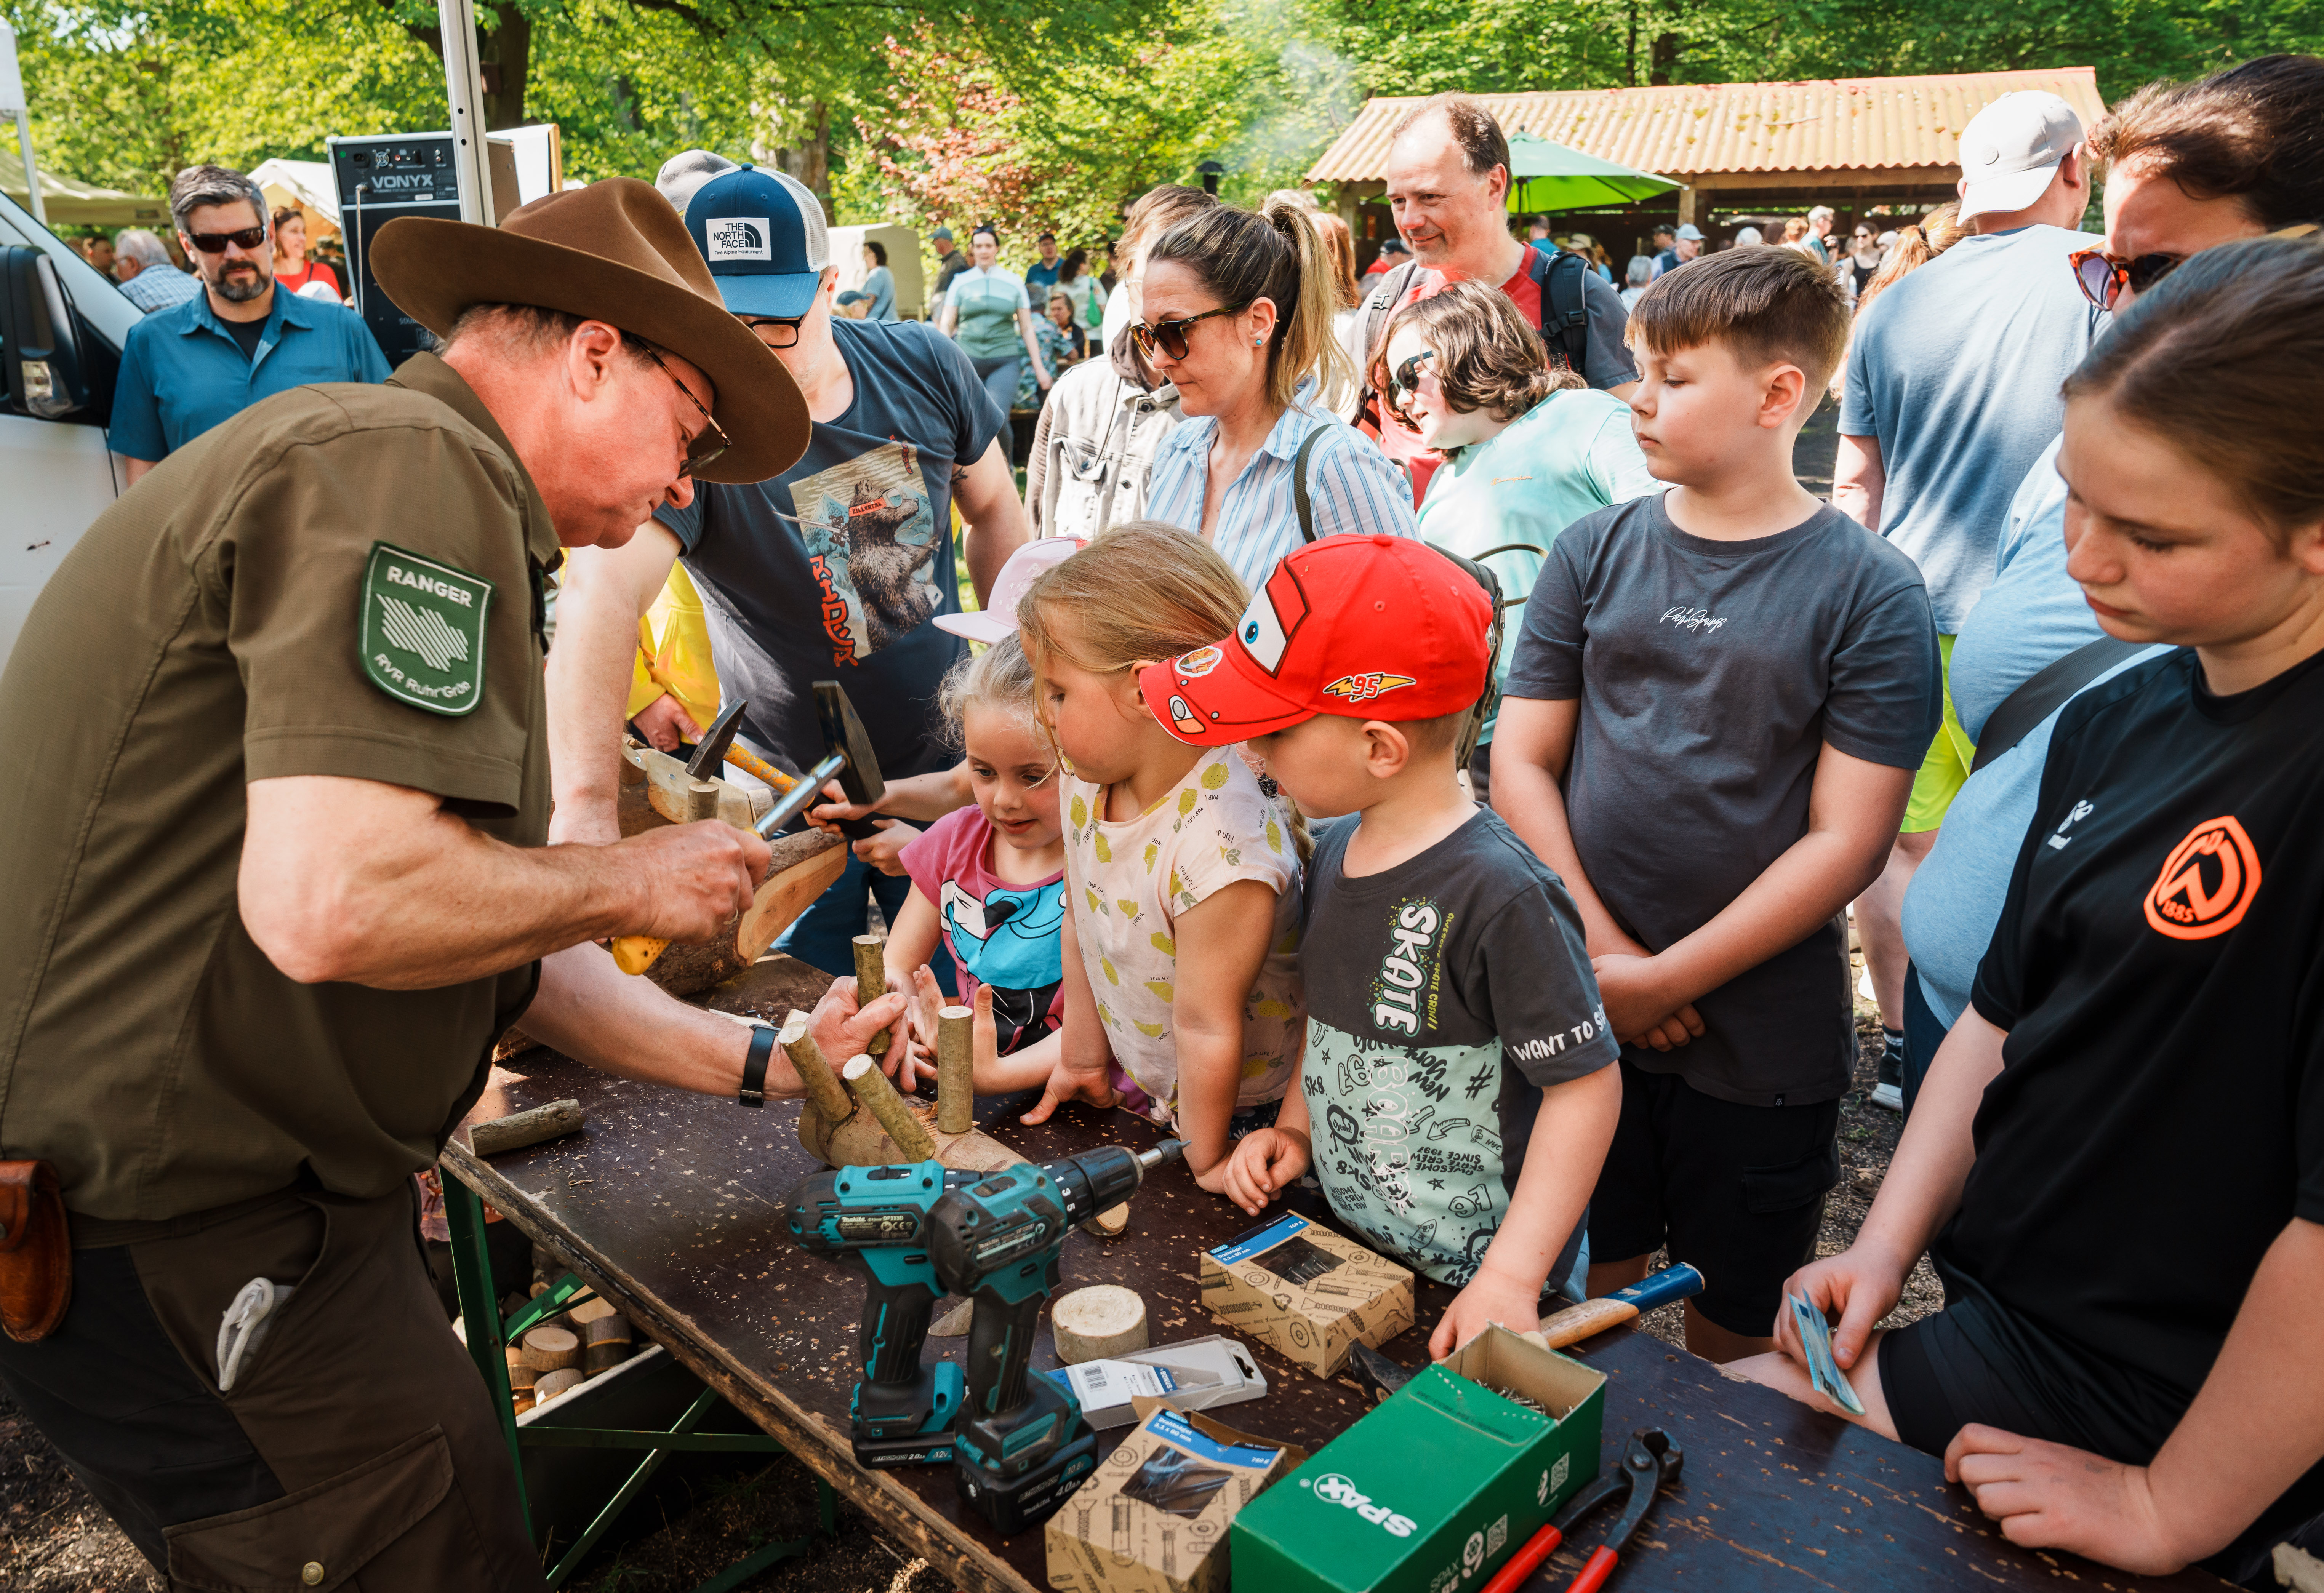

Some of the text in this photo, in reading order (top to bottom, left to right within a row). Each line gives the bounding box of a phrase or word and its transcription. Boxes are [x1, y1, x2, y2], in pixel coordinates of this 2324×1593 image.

[371, 174, 434, 188] VONYX
[714, 231, 744, 241] NORTH
[722, 240, 744, 248] FACE
[852, 501, 883, 514] ZILLERTAL
[386, 565, 472, 608] RANGER
[374, 653, 405, 683] RVR
[1349, 675, 1381, 698] 95
[2162, 899, 2194, 923] 1885
[1374, 904, 1439, 1034] SKATE
[1430, 962, 1440, 992] SKATE
[1513, 1033, 1565, 1061] WANT
[1571, 1021, 1593, 1044] TO
[1305, 1075, 1325, 1097] SK8
[1408, 1070, 1450, 1102] New
[1485, 1139, 1502, 1150] NYC
[1410, 1153, 1484, 1171] SKATE CREW
[1417, 1146, 1481, 1164] SINCE 1997
[1336, 1160, 1372, 1191] SK8
[1414, 1162, 1474, 1175] AWESOME
[1062, 1188, 1071, 1197] 3
[1345, 1193, 1365, 1203] CREW
[1067, 1203, 1075, 1212] 5
[1211, 1244, 1228, 1253] GECCO
[1217, 1246, 1243, 1259] Drahtnägel
[1160, 1371, 1173, 1389] BONUS
[1158, 1417, 1193, 1435] Drahtnägel
[1179, 1433, 1192, 1443] mm
[1314, 1473, 1418, 1538] SPAX
